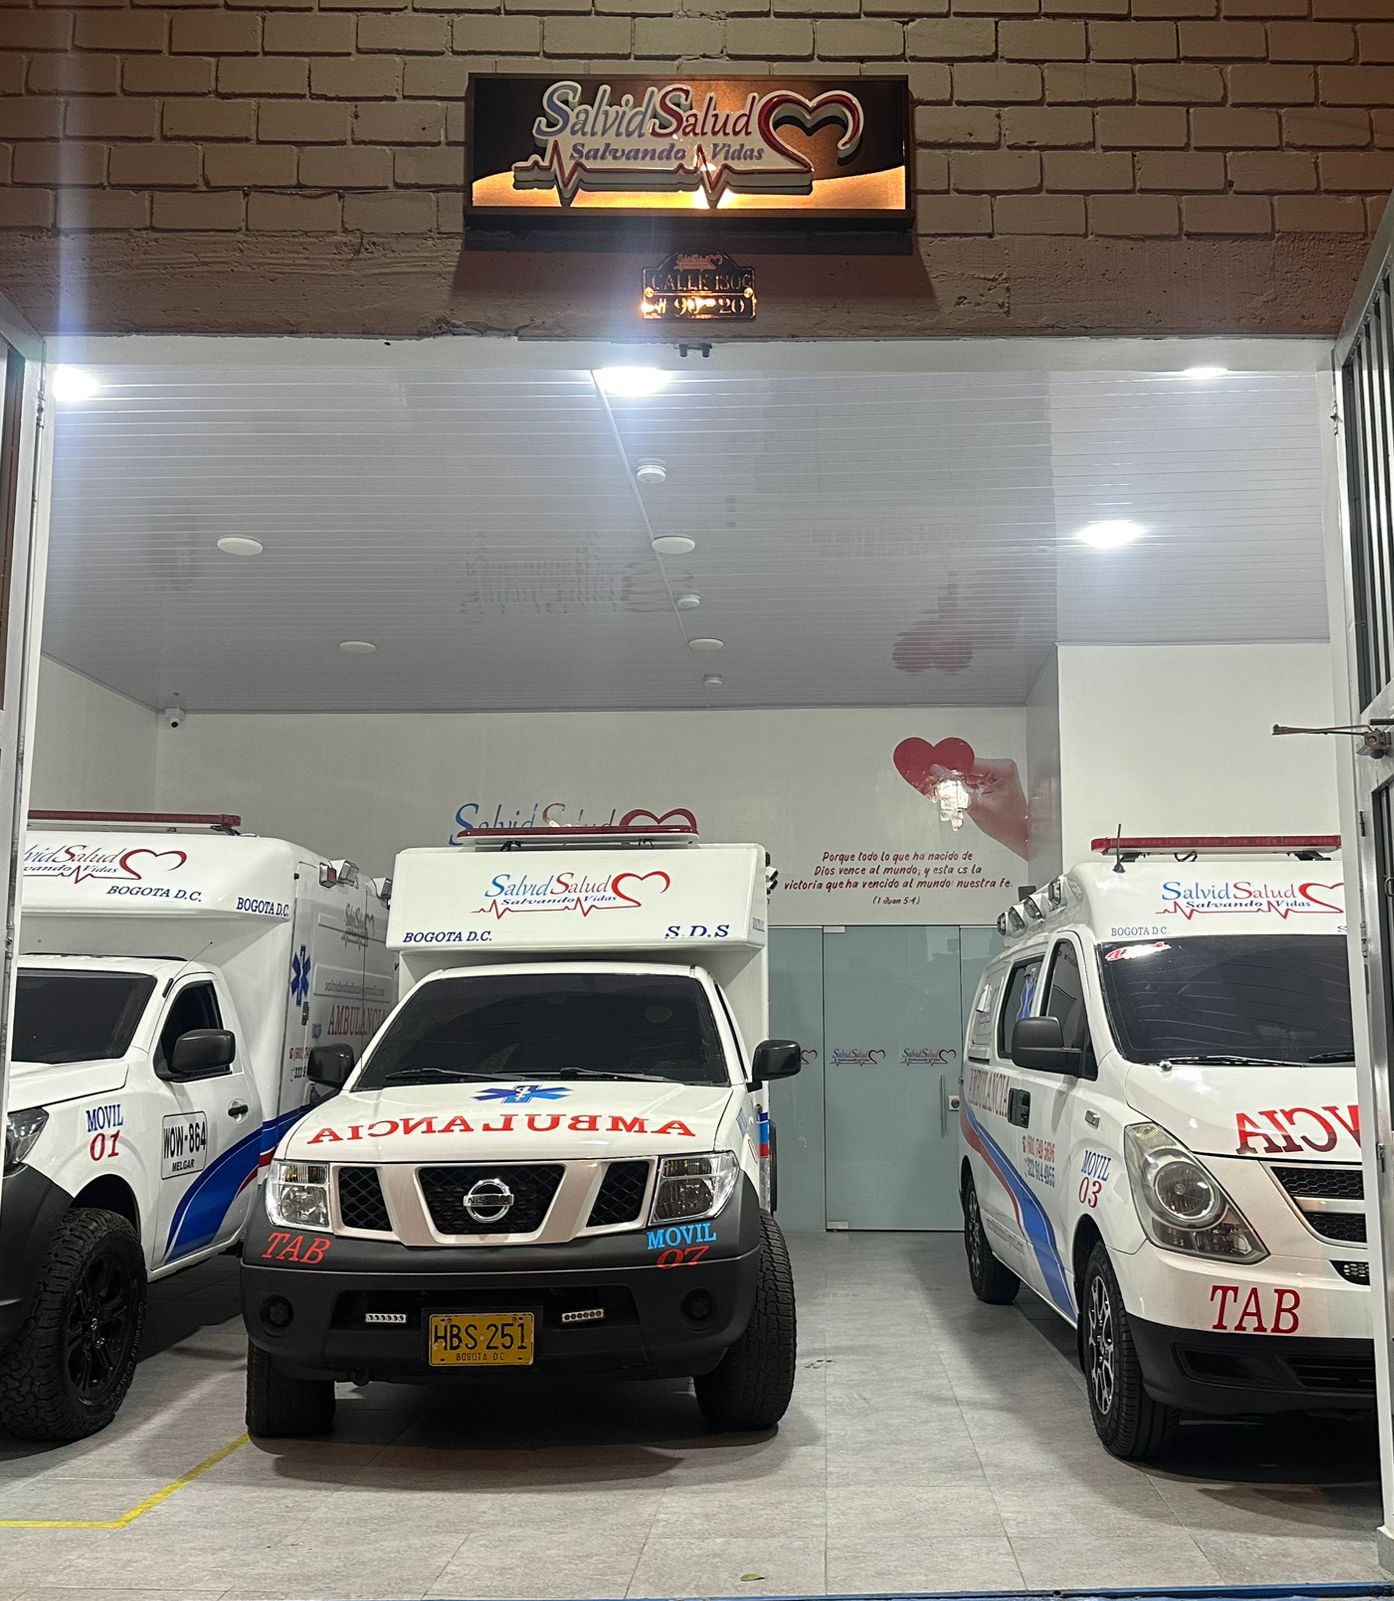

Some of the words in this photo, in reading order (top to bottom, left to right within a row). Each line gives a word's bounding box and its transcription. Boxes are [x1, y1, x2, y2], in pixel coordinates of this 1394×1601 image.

[569, 142, 687, 162] Salvando
[710, 143, 764, 162] Vidas
[651, 274, 709, 290] CALLE
[822, 851, 855, 865] Porque
[858, 851, 878, 862] todo
[880, 851, 890, 862] lo
[892, 853, 910, 865] que
[912, 851, 925, 861] ha
[927, 851, 959, 861] nacido
[961, 851, 973, 861] de
[79, 864, 119, 874] Vidas
[814, 866, 835, 876] Dios
[839, 867, 867, 875] vence
[869, 865, 880, 875] al
[923, 867, 931, 878] y
[932, 865, 954, 875] esta
[971, 864, 982, 874] la
[106, 885, 170, 899] BOGOTA
[172, 889, 202, 902] D.C.
[784, 880, 823, 890] victoria
[825, 881, 844, 893] que
[845, 879, 859, 889] ha
[862, 879, 899, 890] vencido
[902, 878, 914, 888] al
[956, 878, 997, 888] nuestra
[236, 896, 274, 915] BOGOTA
[275, 903, 289, 917] D.C.
[500, 895, 574, 906] Salvando
[583, 894, 617, 903] Vidas
[1185, 900, 1263, 908] Salvando
[403, 932, 462, 944] BOGOTA
[465, 930, 492, 942] D.C.
[1111, 927, 1150, 937] BOGOTA
[86, 1104, 124, 1132] MOVIL
[90, 1130, 121, 1161] 01
[172, 1159, 195, 1172] MELGAR
[1081, 1150, 1111, 1182] MOVIL
[1078, 1176, 1102, 1209] 03
[647, 1223, 717, 1251] MOVIL
[261, 1232, 332, 1266] TAB
[655, 1246, 709, 1270] 07
[1210, 1285, 1301, 1335] TAB
[456, 1352, 487, 1361] BOGOTA
